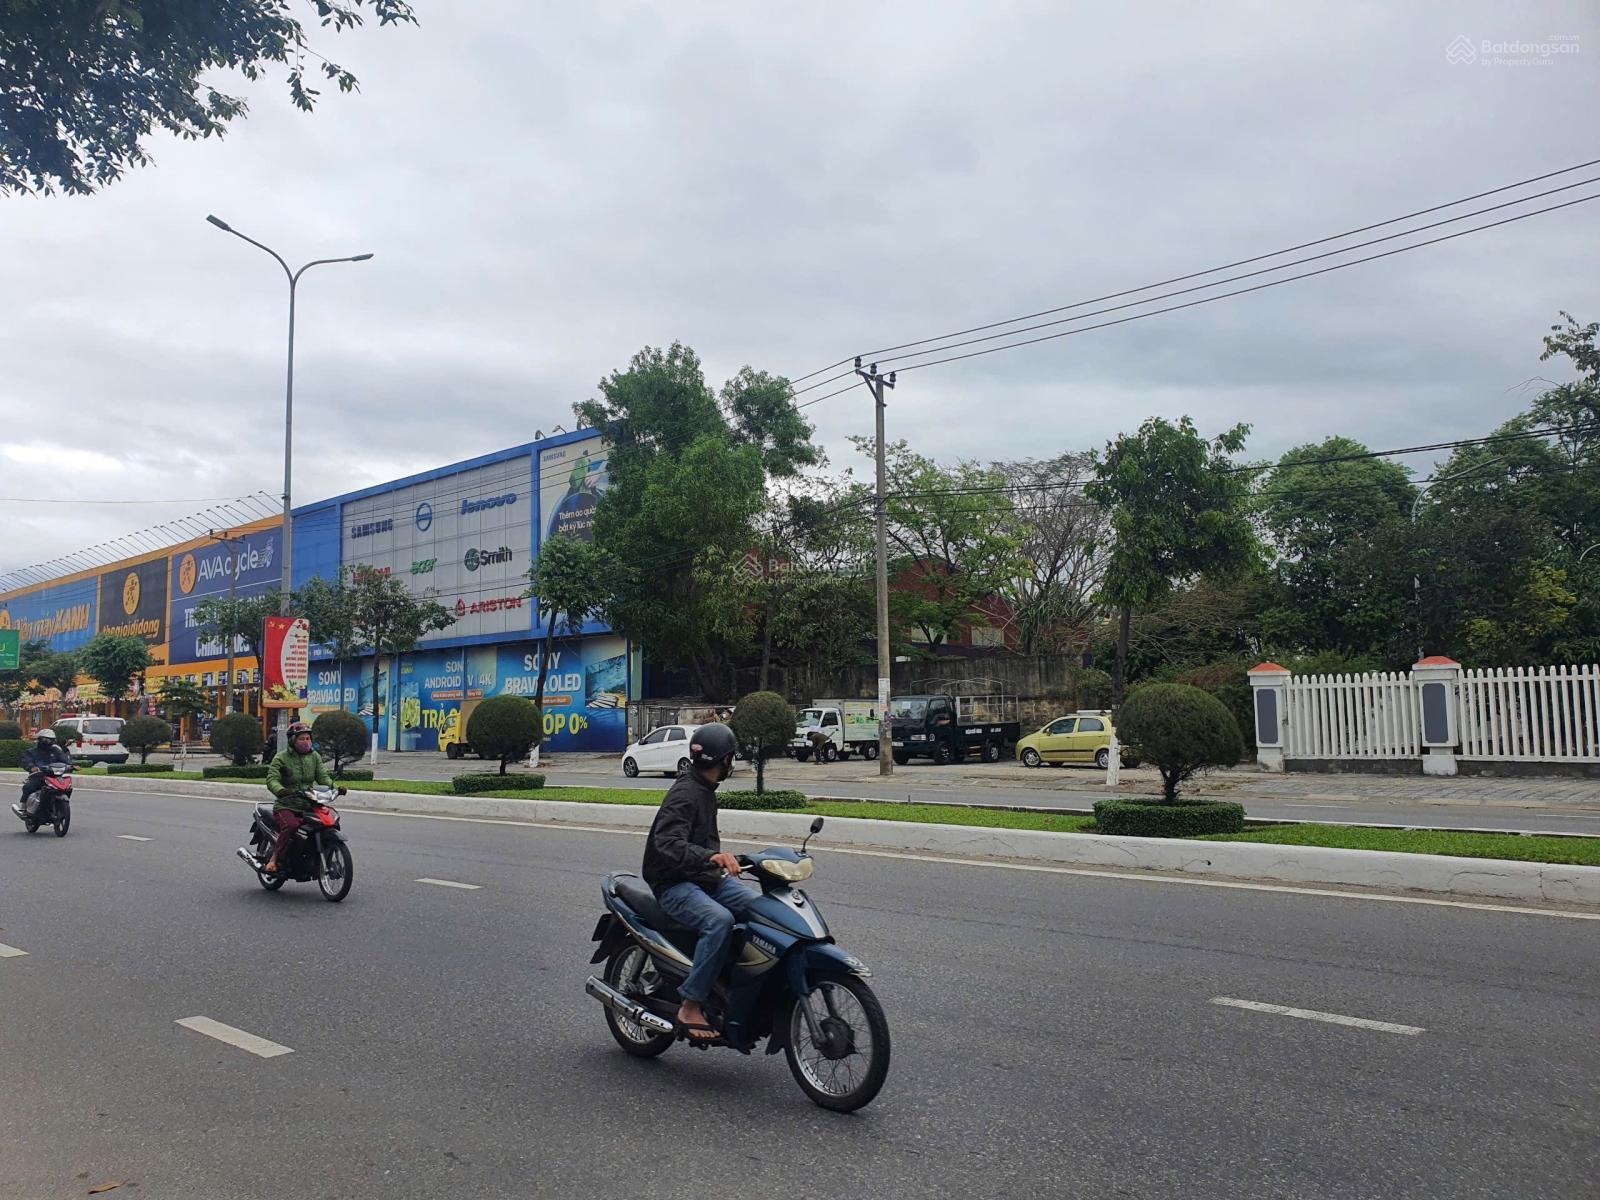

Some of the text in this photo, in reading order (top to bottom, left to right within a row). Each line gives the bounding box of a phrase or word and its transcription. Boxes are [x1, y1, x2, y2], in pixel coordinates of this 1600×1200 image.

[351, 518, 393, 539] SAMSUNG
[480, 546, 512, 566] Smith
[470, 597, 521, 614] ARISTON
[446, 661, 465, 673] SON
[424, 676, 461, 689] ANDROID
[551, 673, 581, 692] OLED
[334, 687, 356, 703] OED
[752, 934, 777, 955] YAMAHA
